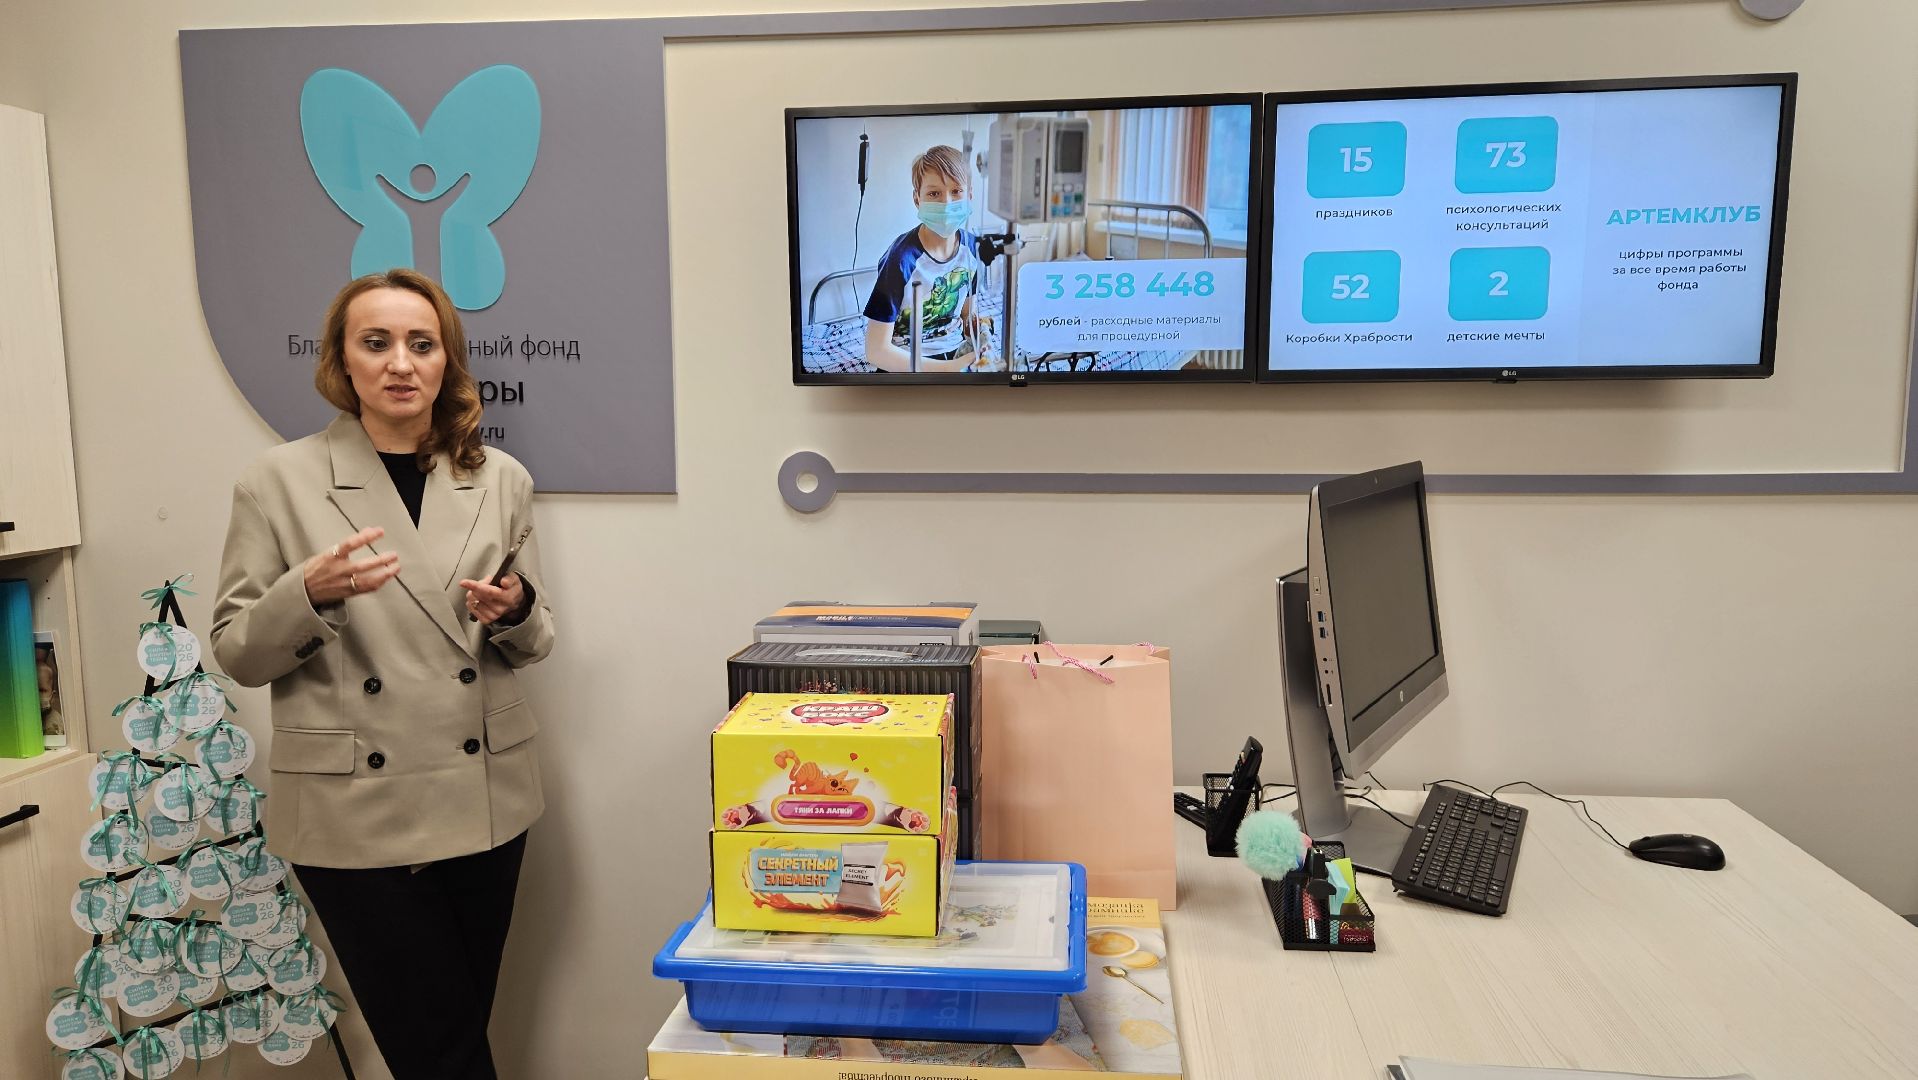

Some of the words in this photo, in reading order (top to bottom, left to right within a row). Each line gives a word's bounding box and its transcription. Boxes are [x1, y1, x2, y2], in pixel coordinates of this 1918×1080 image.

[1339, 146, 1373, 173] 15
[1486, 141, 1527, 168] 73
[1316, 208, 1393, 220] праздников
[1446, 203, 1562, 215] психологических
[1606, 205, 1761, 226] АРТЕМКЛУБ
[1456, 219, 1550, 232] консультаций
[1619, 249, 1664, 260] цифры
[1667, 248, 1743, 259] программы
[1612, 267, 1626, 275] за
[1630, 266, 1651, 274] все
[1655, 265, 1696, 275] время
[1699, 262, 1747, 275] работы
[1045, 274, 1065, 299] 3
[1074, 272, 1136, 299] 258
[1146, 270, 1215, 297] 448
[1331, 274, 1370, 300] 52
[1488, 271, 1509, 296] 2
[1657, 281, 1699, 291] фонда
[1039, 316, 1081, 328] рублей
[1091, 316, 1154, 327] расходные
[1156, 315, 1221, 326] материалы
[1078, 332, 1098, 341] для
[1101, 331, 1180, 342] процедурной
[1286, 333, 1341, 345] Коробки
[1344, 332, 1413, 344] Храбрости
[1447, 331, 1500, 342] детские
[1504, 332, 1545, 342] мечты
[520, 333, 581, 362] фонд
[201, 697, 217, 705] 20
[201, 706, 217, 715] 26
[826, 807, 853, 815] ЛАПКИ
[758, 855, 839, 872] СЕКРЕТНЫЙ
[764, 873, 830, 887] ЭЛЕМЕНТ
[259, 902, 273, 911] 20
[260, 911, 275, 920] 26
